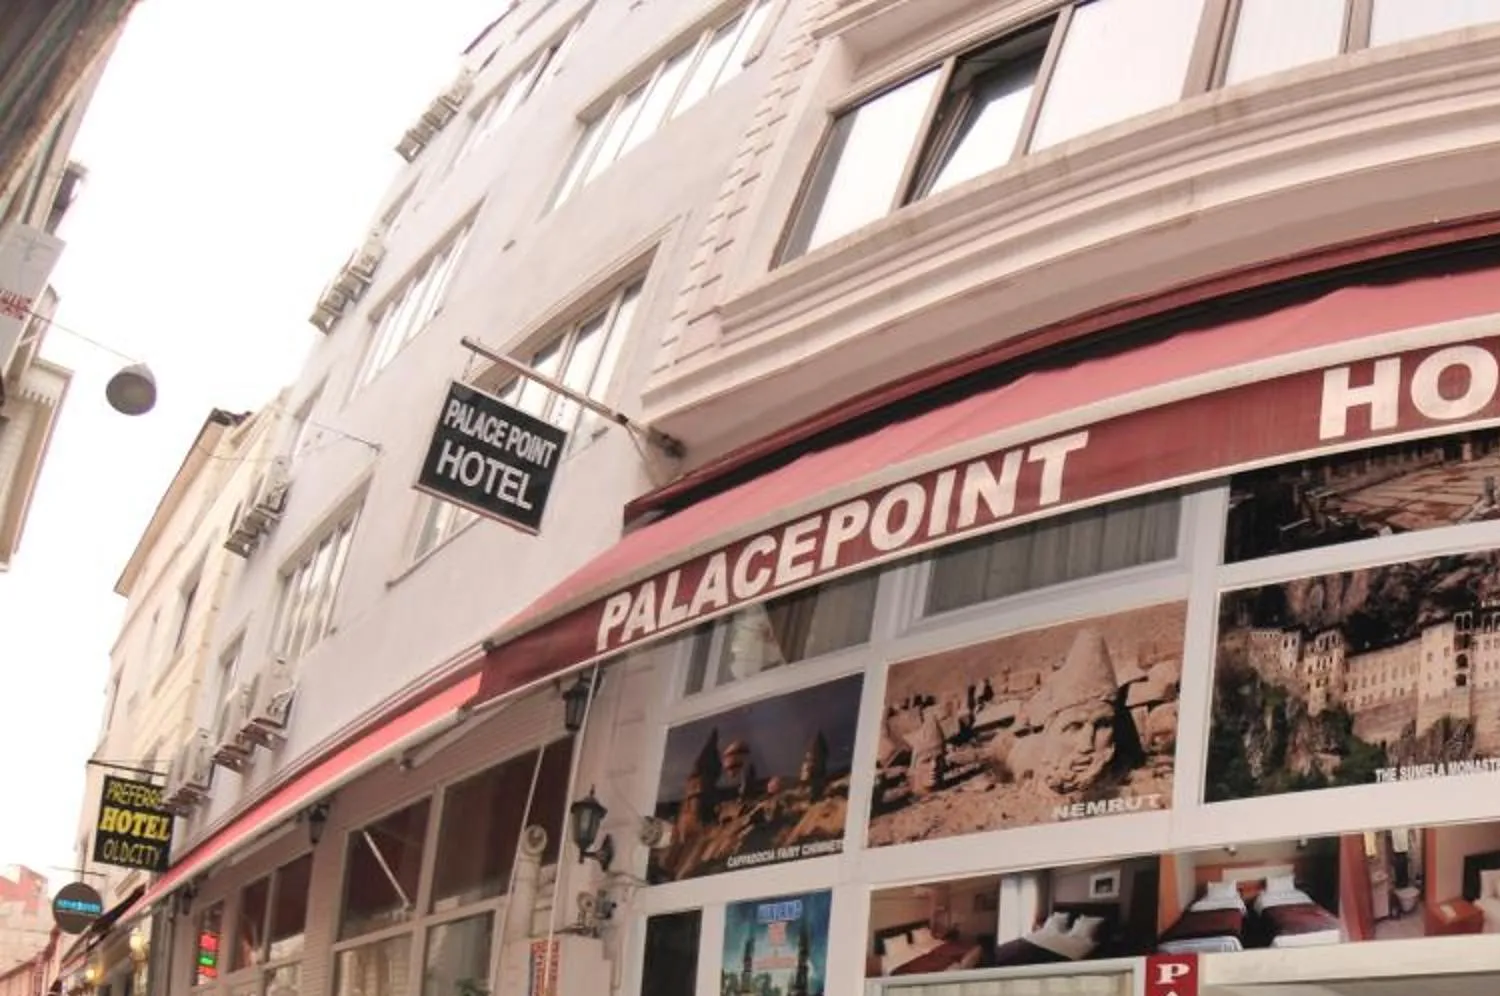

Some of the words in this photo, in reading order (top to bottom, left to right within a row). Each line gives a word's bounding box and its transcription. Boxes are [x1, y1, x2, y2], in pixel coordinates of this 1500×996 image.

[443, 399, 509, 449] PALACE
[505, 425, 557, 469] POINT
[435, 439, 533, 511] HOTEL
[98, 806, 171, 842] HOTEL
[1050, 793, 1162, 820] NEMRUT
